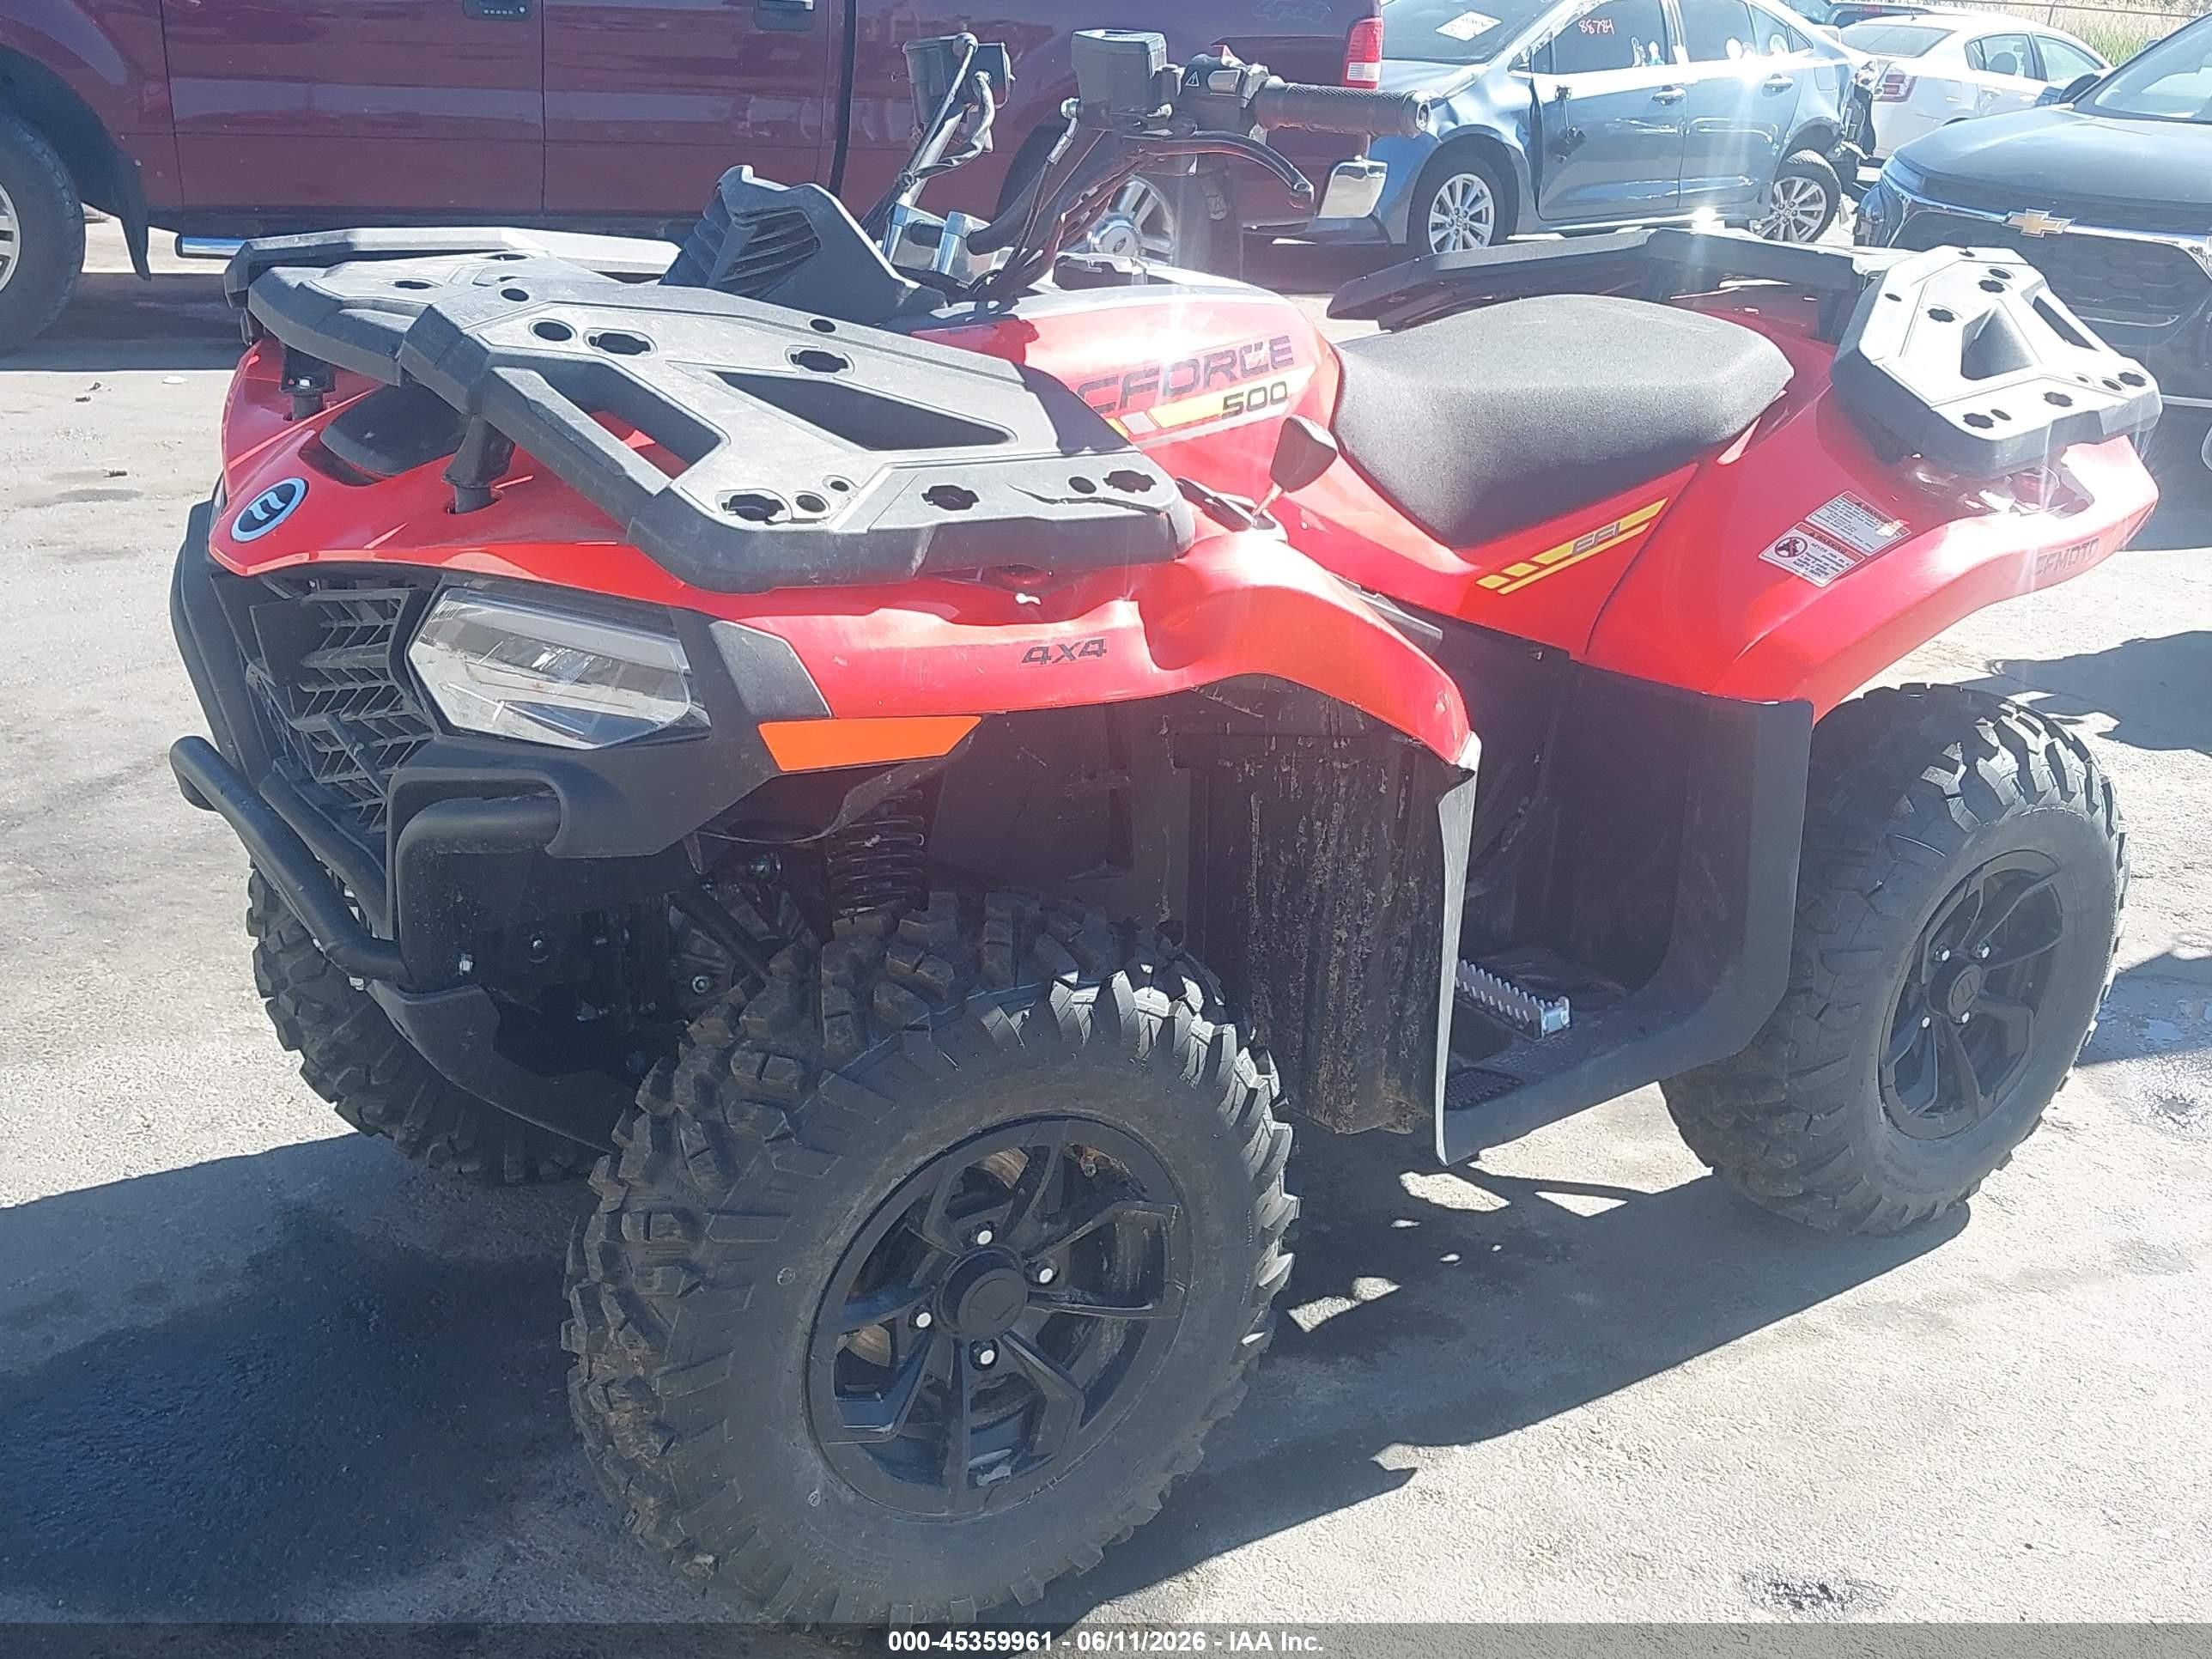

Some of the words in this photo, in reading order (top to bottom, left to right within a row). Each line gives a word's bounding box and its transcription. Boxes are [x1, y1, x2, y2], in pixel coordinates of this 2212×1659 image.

[1077, 335, 1294, 414] CFORCE
[1221, 380, 1288, 420] 500
[1571, 521, 1621, 556] EFI
